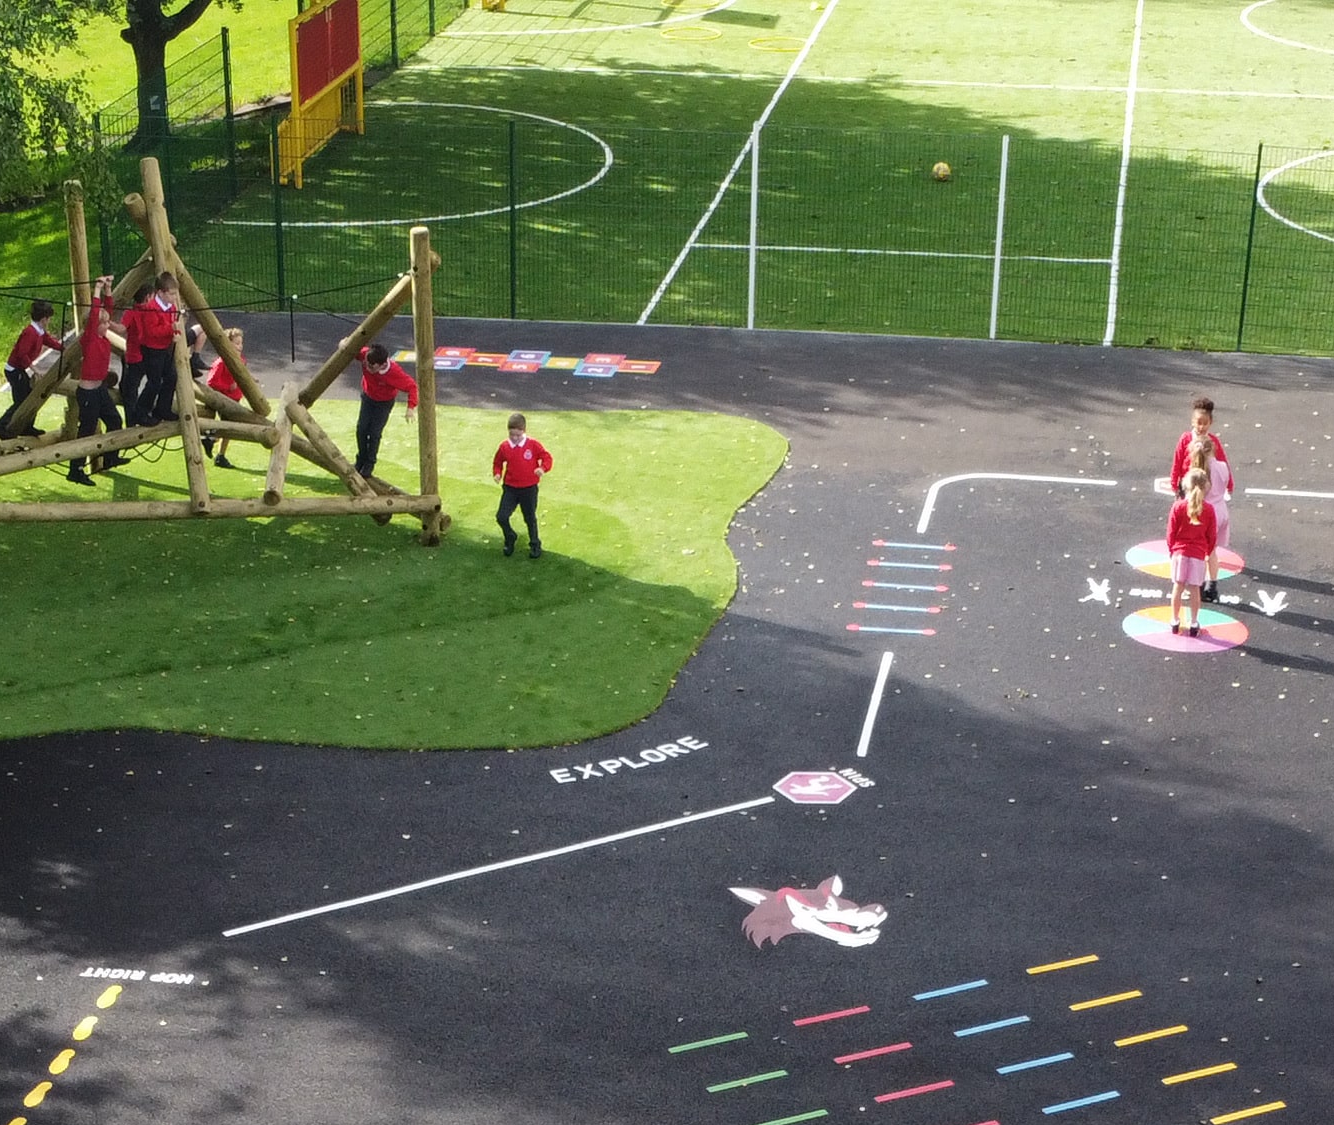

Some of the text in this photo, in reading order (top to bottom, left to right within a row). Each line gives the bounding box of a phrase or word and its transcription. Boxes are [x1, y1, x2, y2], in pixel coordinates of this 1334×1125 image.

[549, 735, 709, 784] EXPLORE
[838, 767, 876, 789] SPIN
[79, 966, 194, 984] HOP RIGHT
